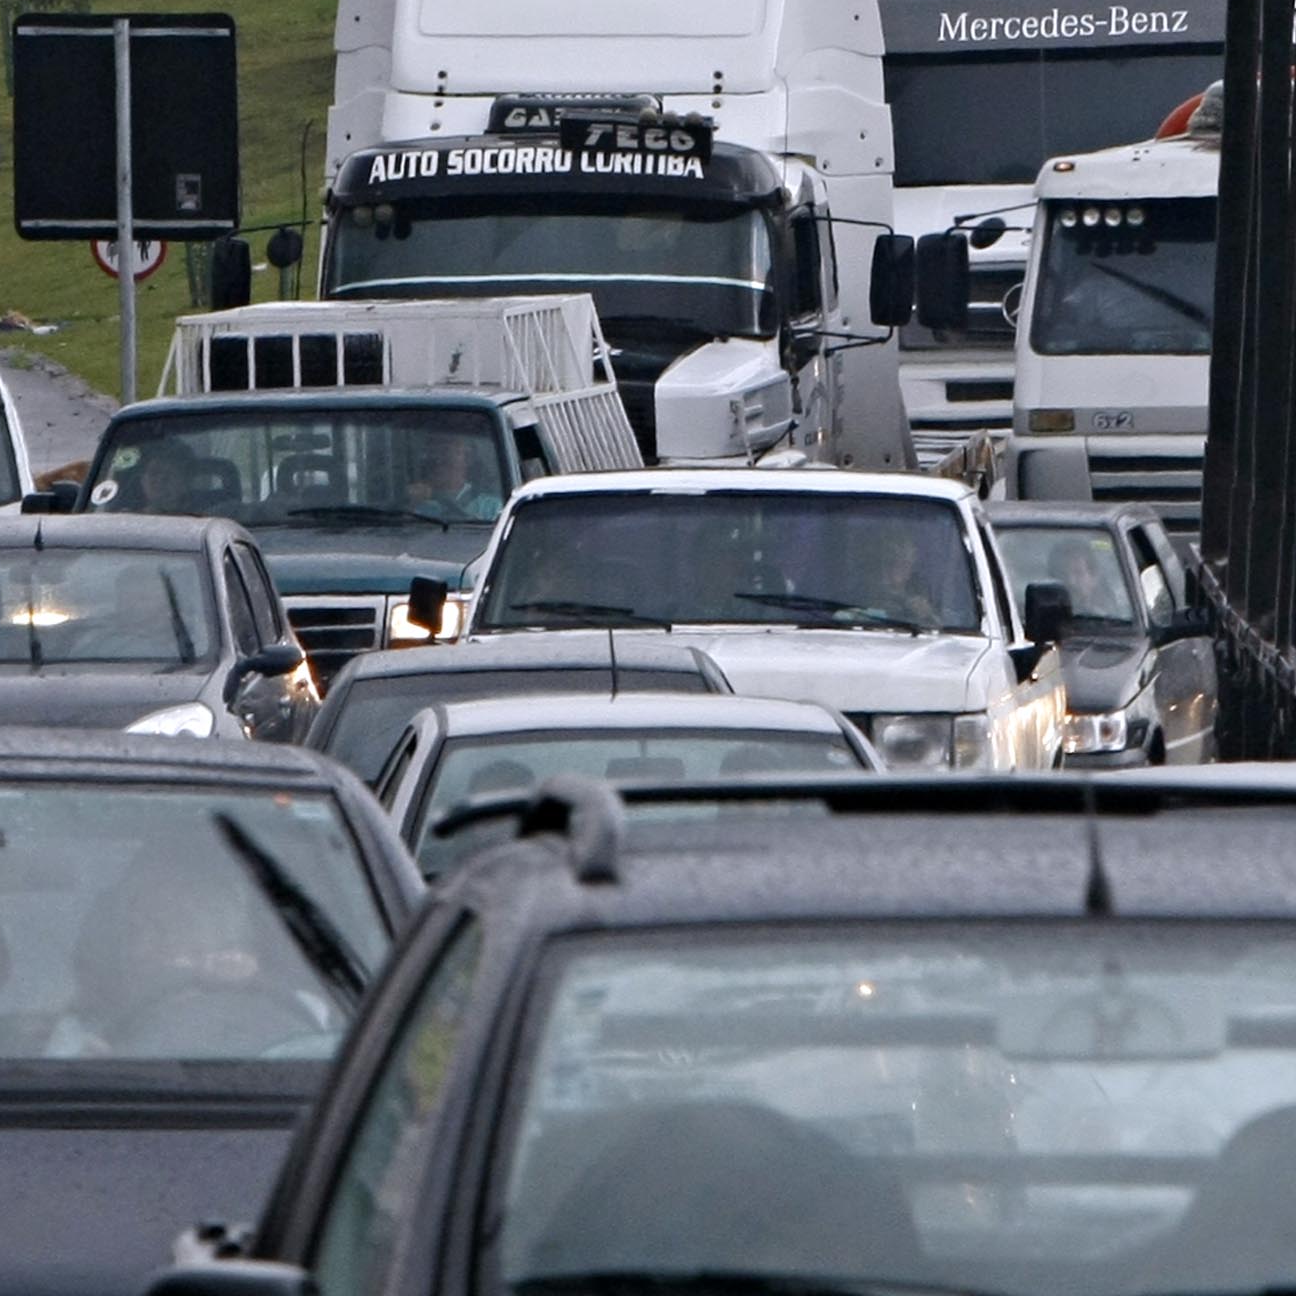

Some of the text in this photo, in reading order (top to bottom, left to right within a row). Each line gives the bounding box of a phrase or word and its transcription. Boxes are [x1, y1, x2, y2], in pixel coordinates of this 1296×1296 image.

[937, 6, 1189, 42] Mercedes-Benz
[368, 146, 705, 184] AUTO SOCORRO CURITIBA
